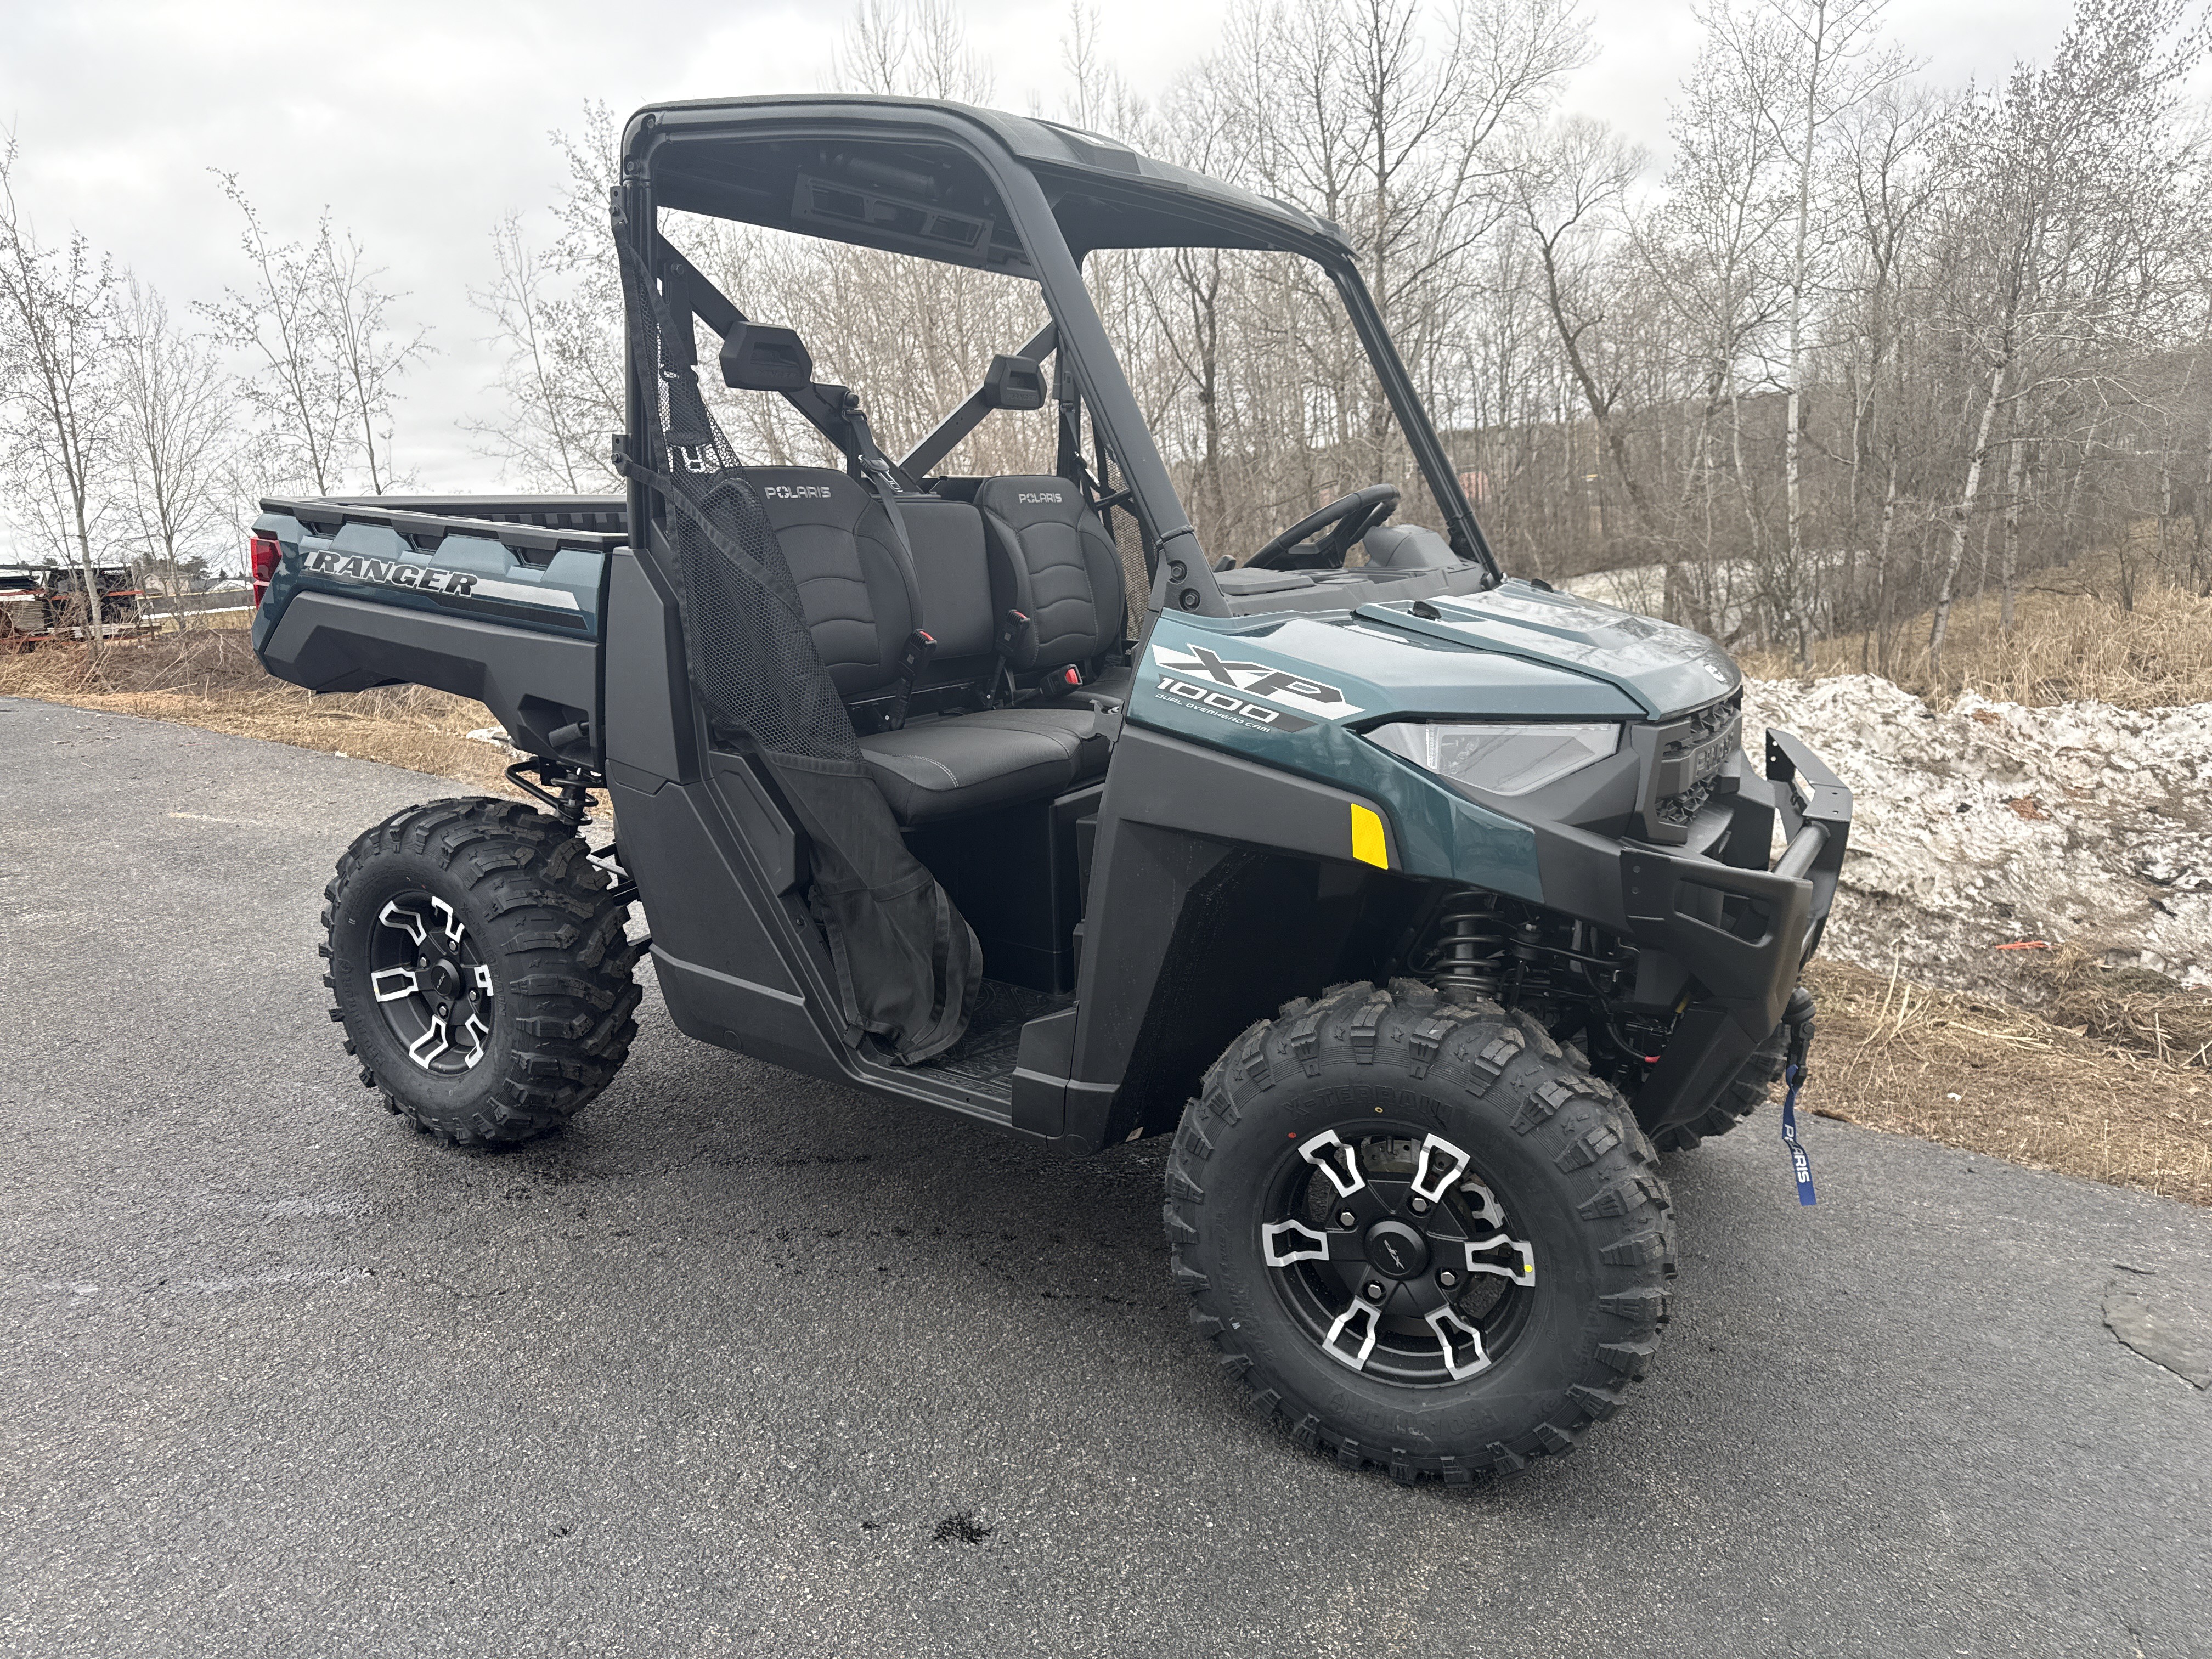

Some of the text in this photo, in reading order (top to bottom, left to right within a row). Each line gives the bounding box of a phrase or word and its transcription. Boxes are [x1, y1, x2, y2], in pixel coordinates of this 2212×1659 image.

[764, 486, 831, 499] POLARIS
[1019, 493, 1062, 504] POLARIS
[310, 550, 477, 597] RANGER
[1159, 644, 1344, 704] XP
[1155, 693, 1271, 733] DUAL OVERHEAD CAM
[1156, 677, 1279, 723] 1000
[1280, 1084, 1453, 1122] X-TERRAIN
